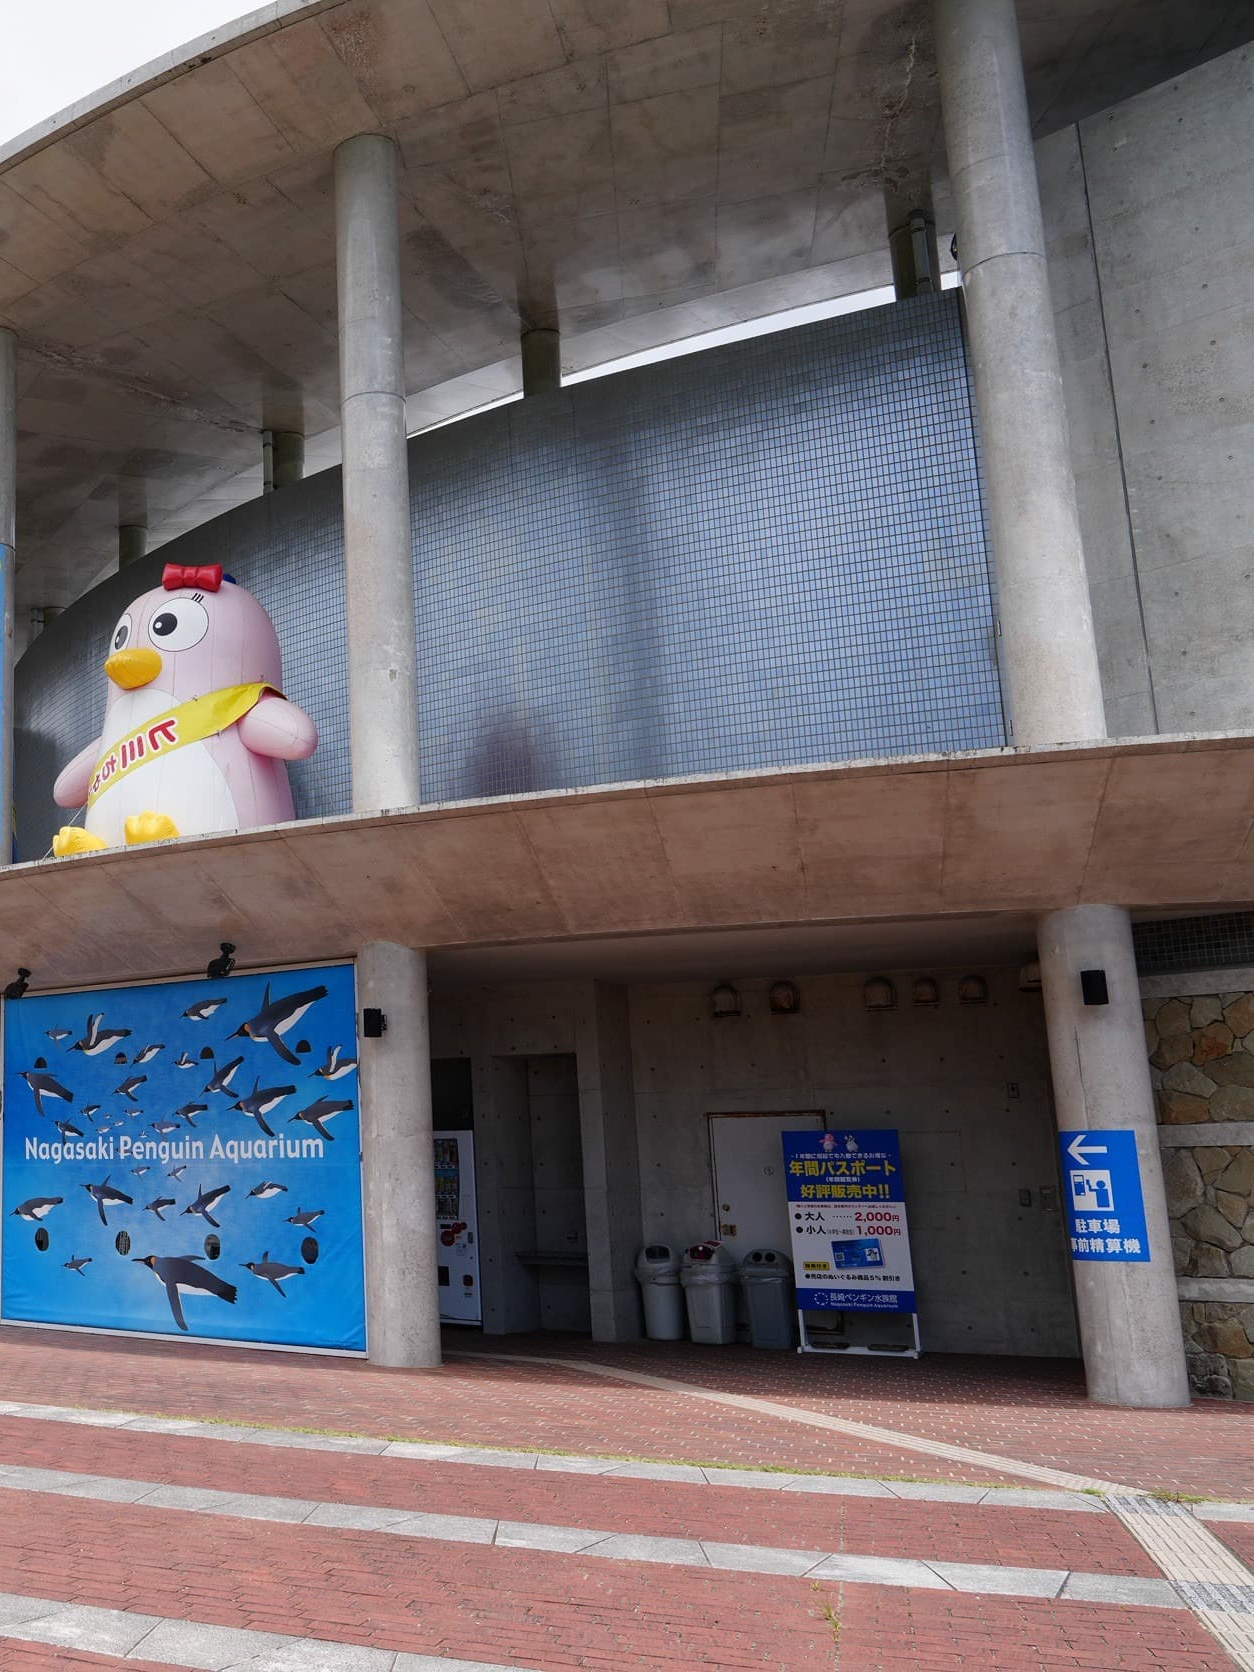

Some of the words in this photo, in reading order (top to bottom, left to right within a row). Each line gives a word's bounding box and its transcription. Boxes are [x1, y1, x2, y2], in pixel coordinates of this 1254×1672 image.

[25, 1136, 114, 1164] Nagasaki
[119, 1135, 204, 1164] Penguin
[209, 1133, 324, 1165] Aquarium
[789, 1159, 896, 1177] 年間パスポート
[800, 1184, 890, 1199] 好評販売中!!
[805, 1211, 826, 1222] 大人
[854, 1212, 900, 1223] 2,000円
[806, 1225, 827, 1236] 小人
[856, 1225, 902, 1236] 1,000円
[1074, 1218, 1121, 1234] 駐車場
